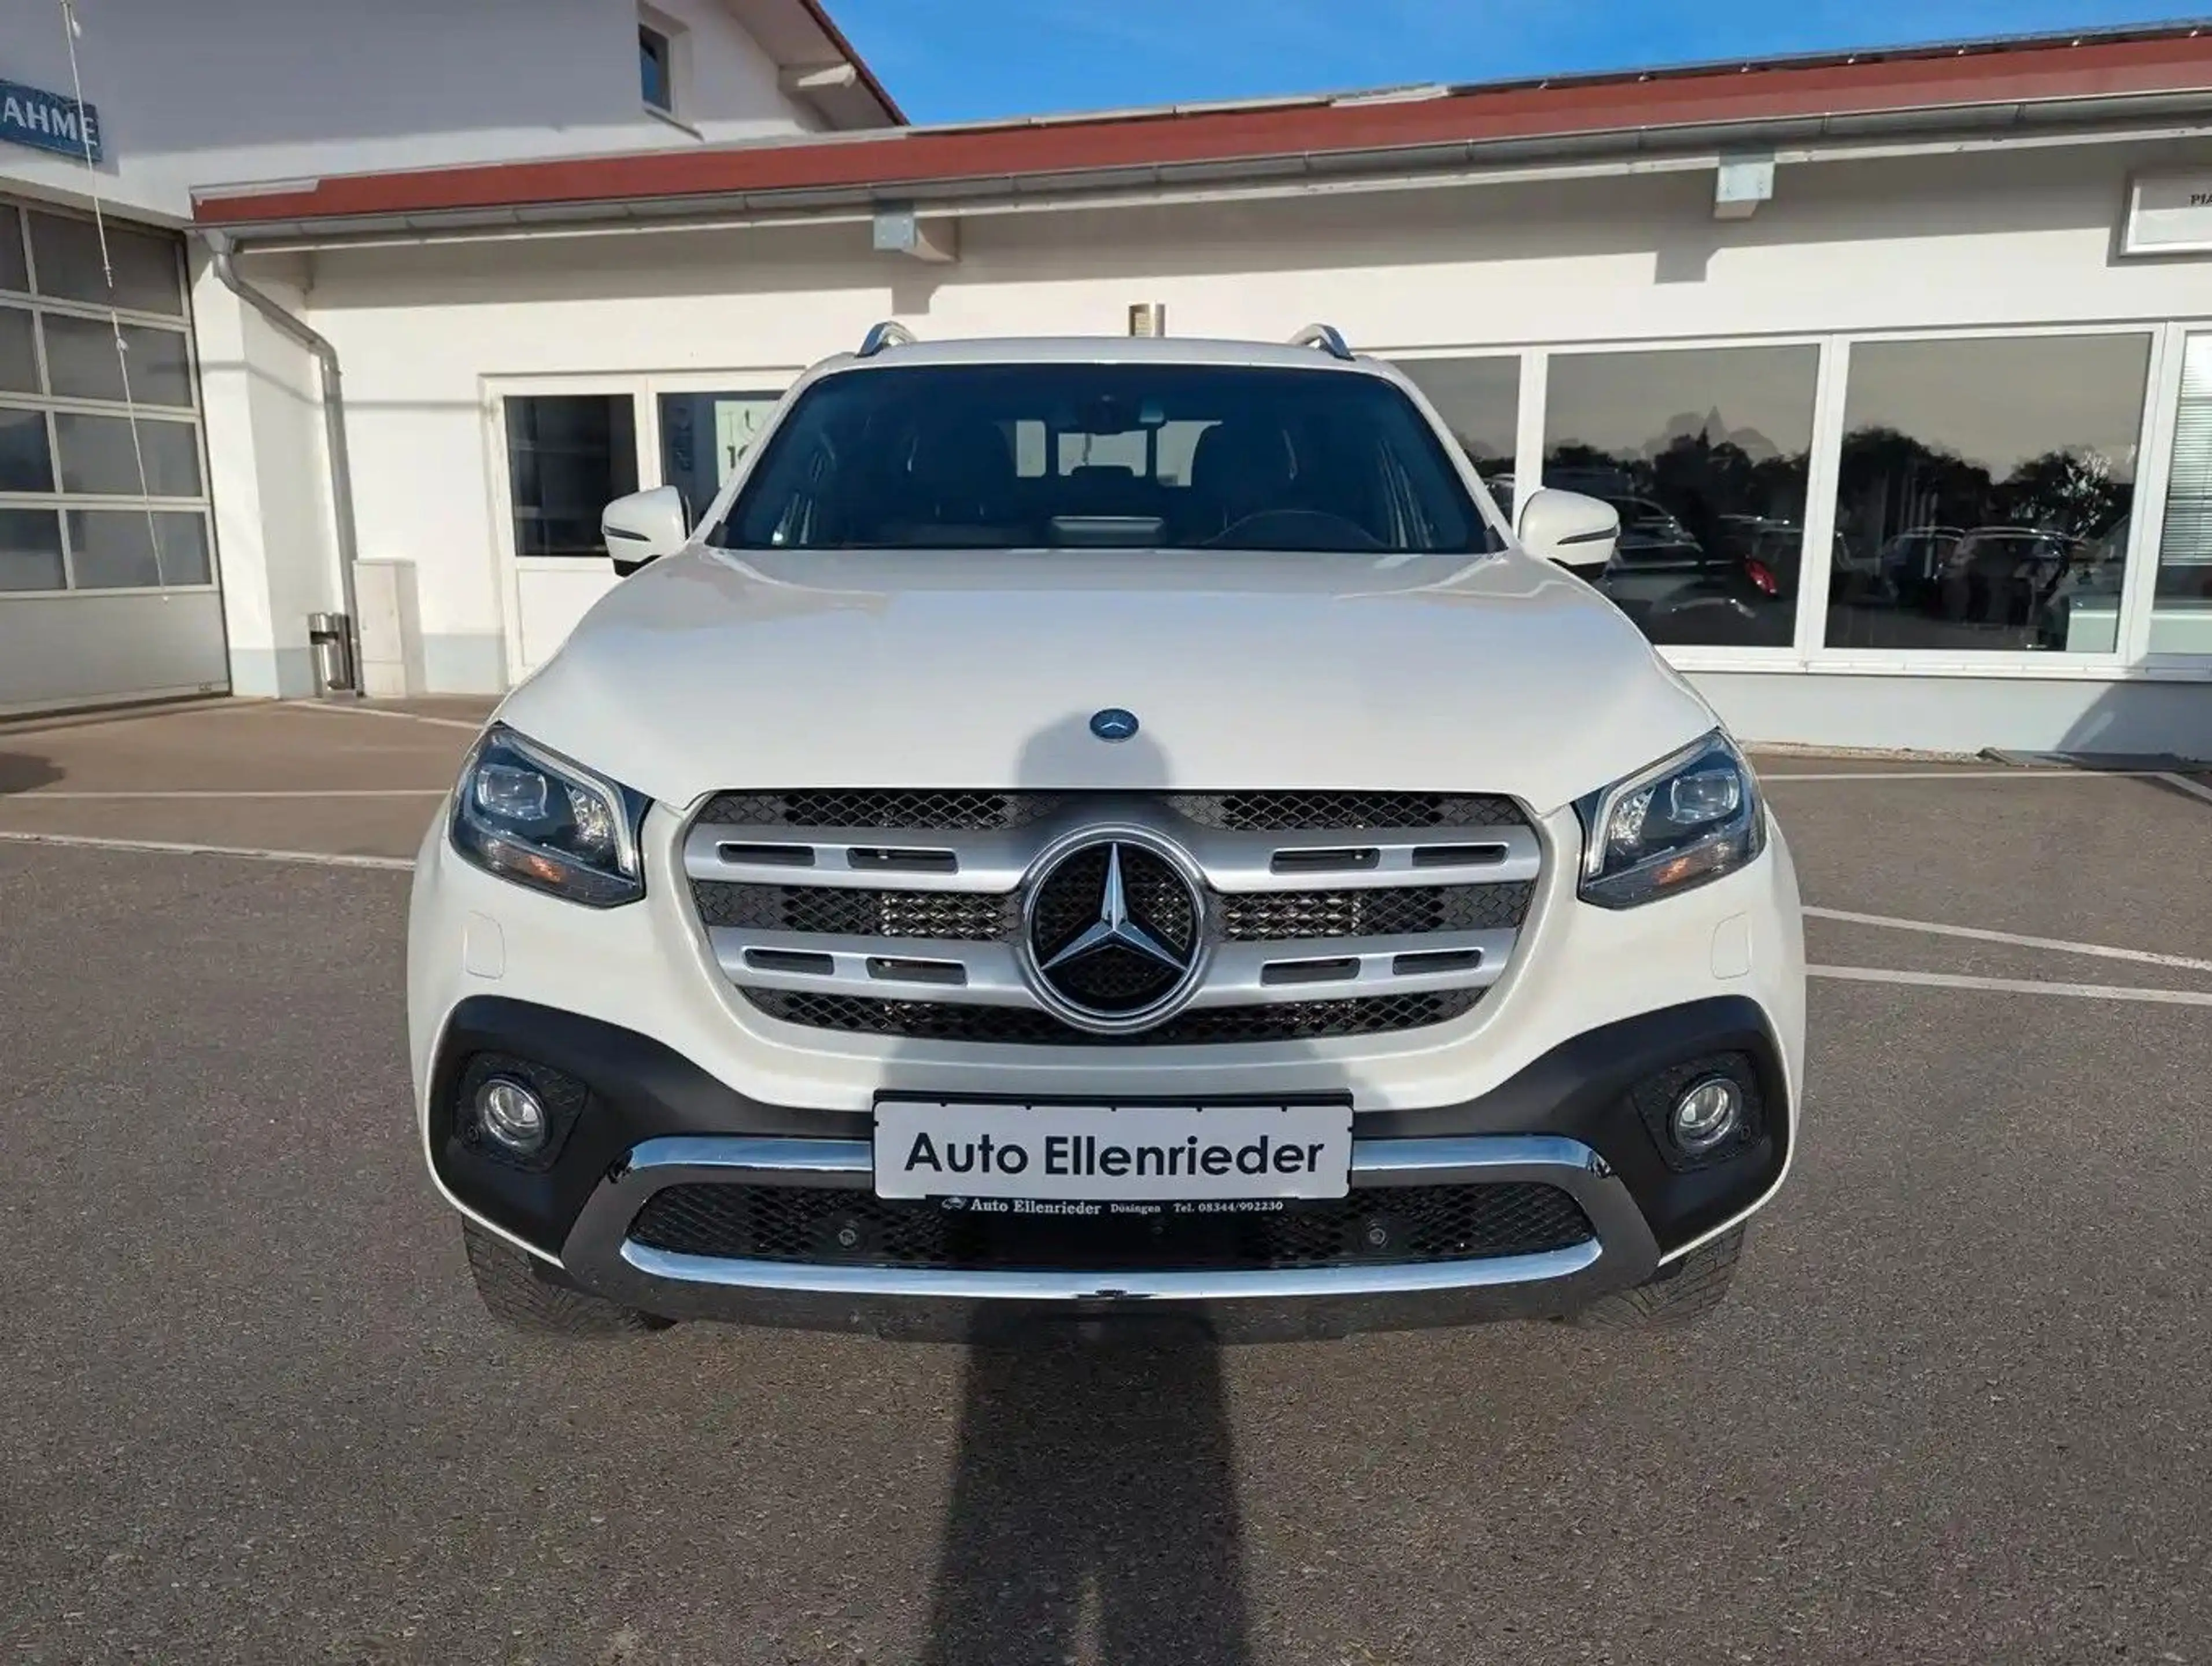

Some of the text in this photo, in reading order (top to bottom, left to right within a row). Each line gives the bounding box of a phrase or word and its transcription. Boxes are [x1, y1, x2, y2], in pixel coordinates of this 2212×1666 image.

[904, 1132, 1324, 1176] Auto Ellenrieder
[970, 1199, 1009, 1212] Auto
[1013, 1200, 1102, 1214] Ellenrieder
[1173, 1203, 1194, 1213] Tel.
